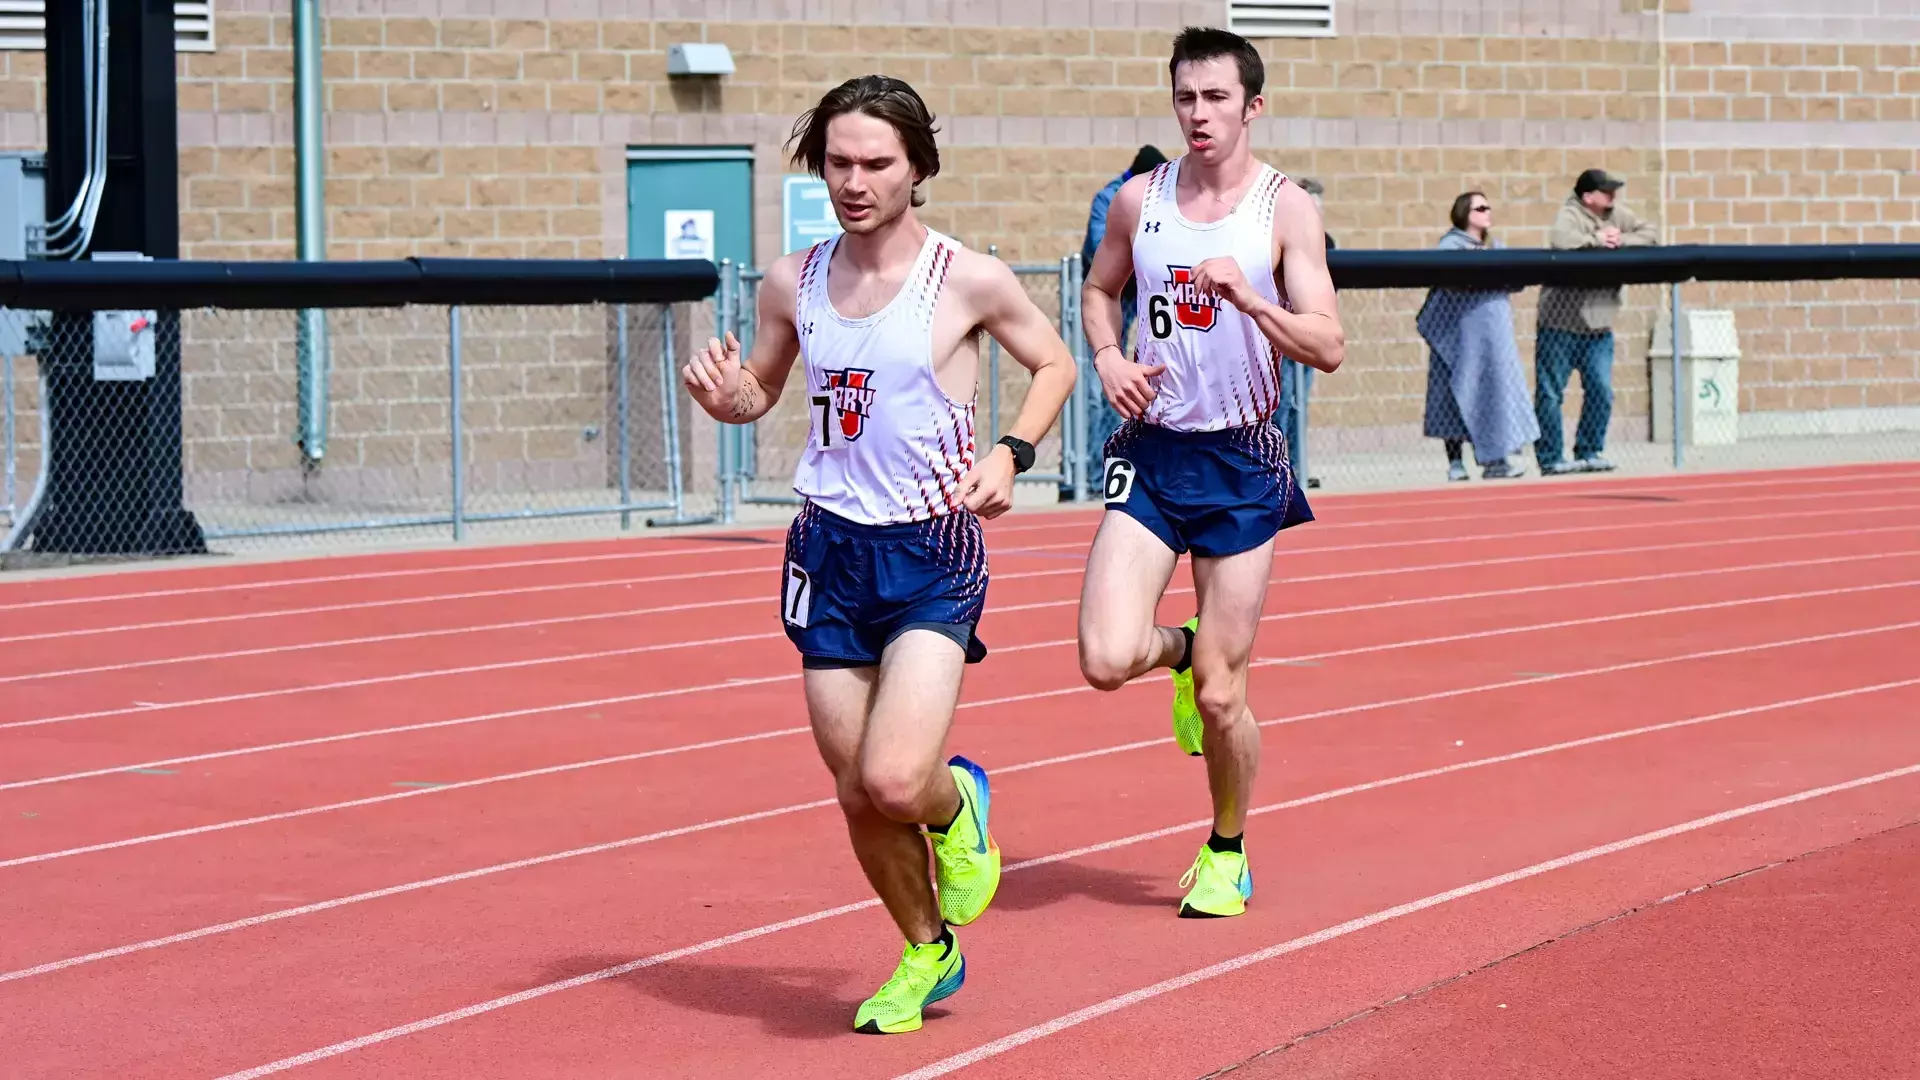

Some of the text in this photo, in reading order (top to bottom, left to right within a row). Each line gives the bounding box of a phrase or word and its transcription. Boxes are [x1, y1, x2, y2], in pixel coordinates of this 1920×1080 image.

[1149, 295, 1172, 339] 6
[812, 396, 831, 446] 7
[1105, 461, 1131, 499] 6
[790, 567, 807, 619] 7
